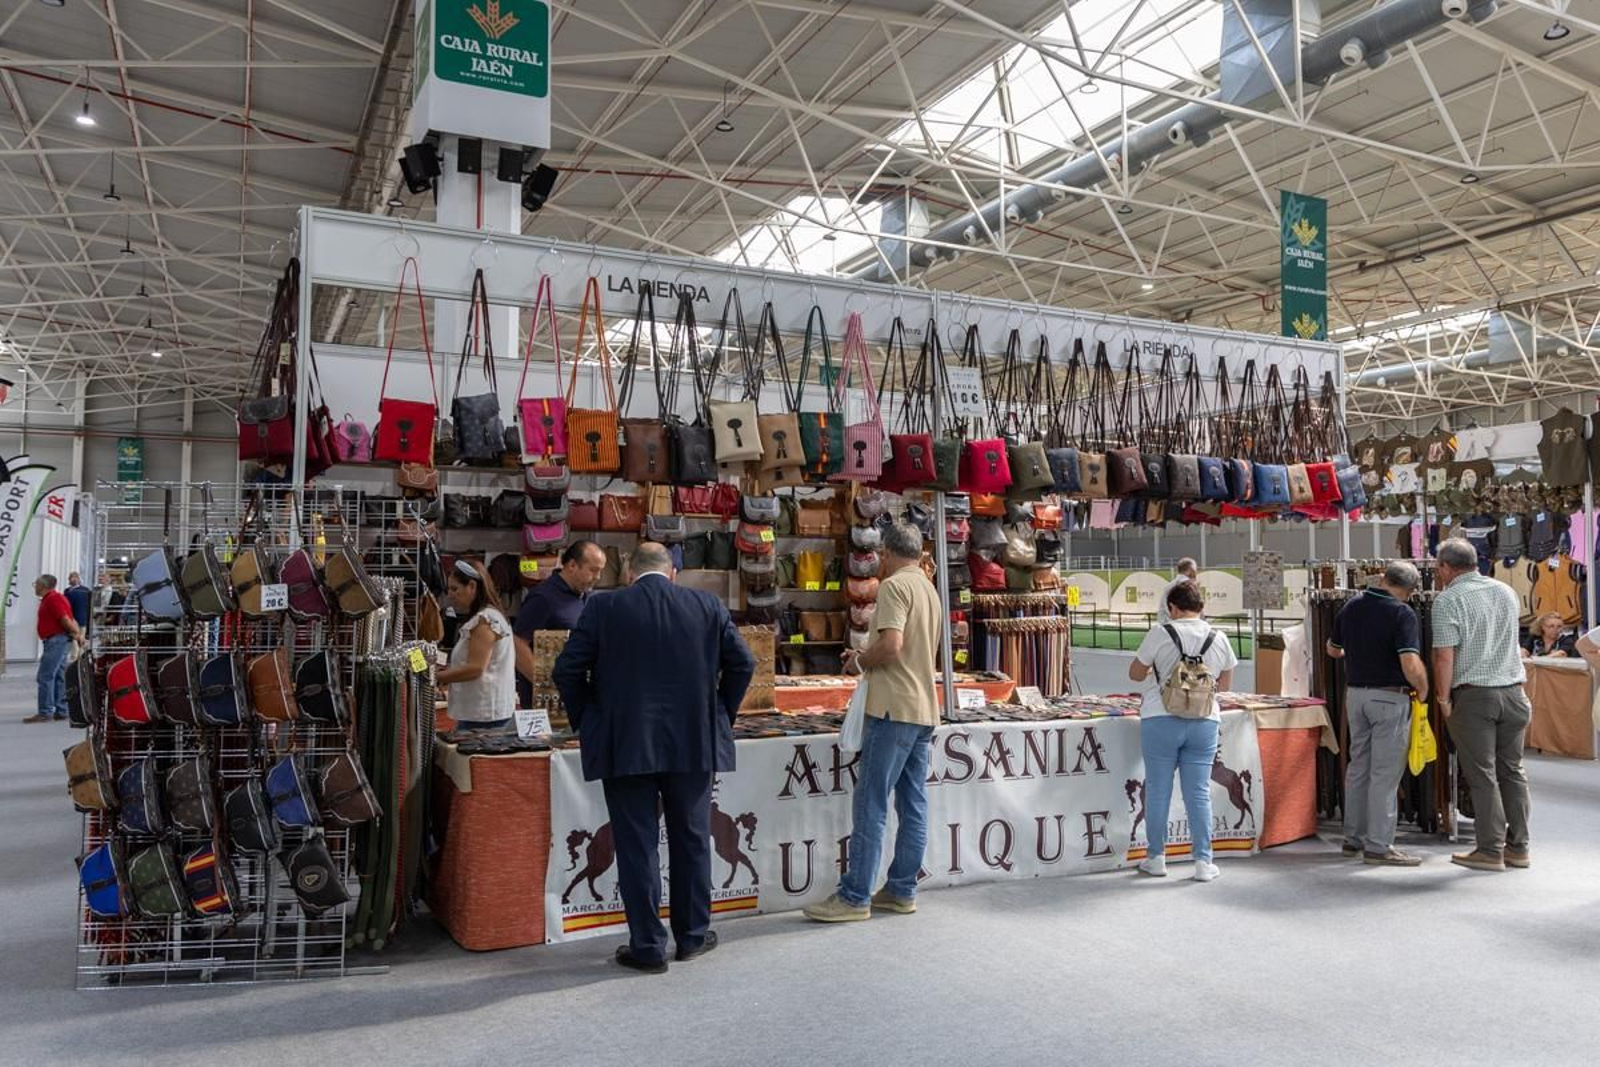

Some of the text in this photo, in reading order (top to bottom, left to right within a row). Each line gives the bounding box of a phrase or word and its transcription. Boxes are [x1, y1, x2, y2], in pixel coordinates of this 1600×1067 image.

[440, 33, 543, 66] CAJA RURAL
[471, 57, 514, 78] JAÉN
[608, 275, 711, 303] LA RIENDA
[1123, 338, 1193, 359] LA RIENDA
[0, 475, 30, 558] ASPORT
[777, 727, 1110, 800] ARSANIA
[778, 811, 1115, 896] UIQUE
[561, 903, 604, 914] MARCA
